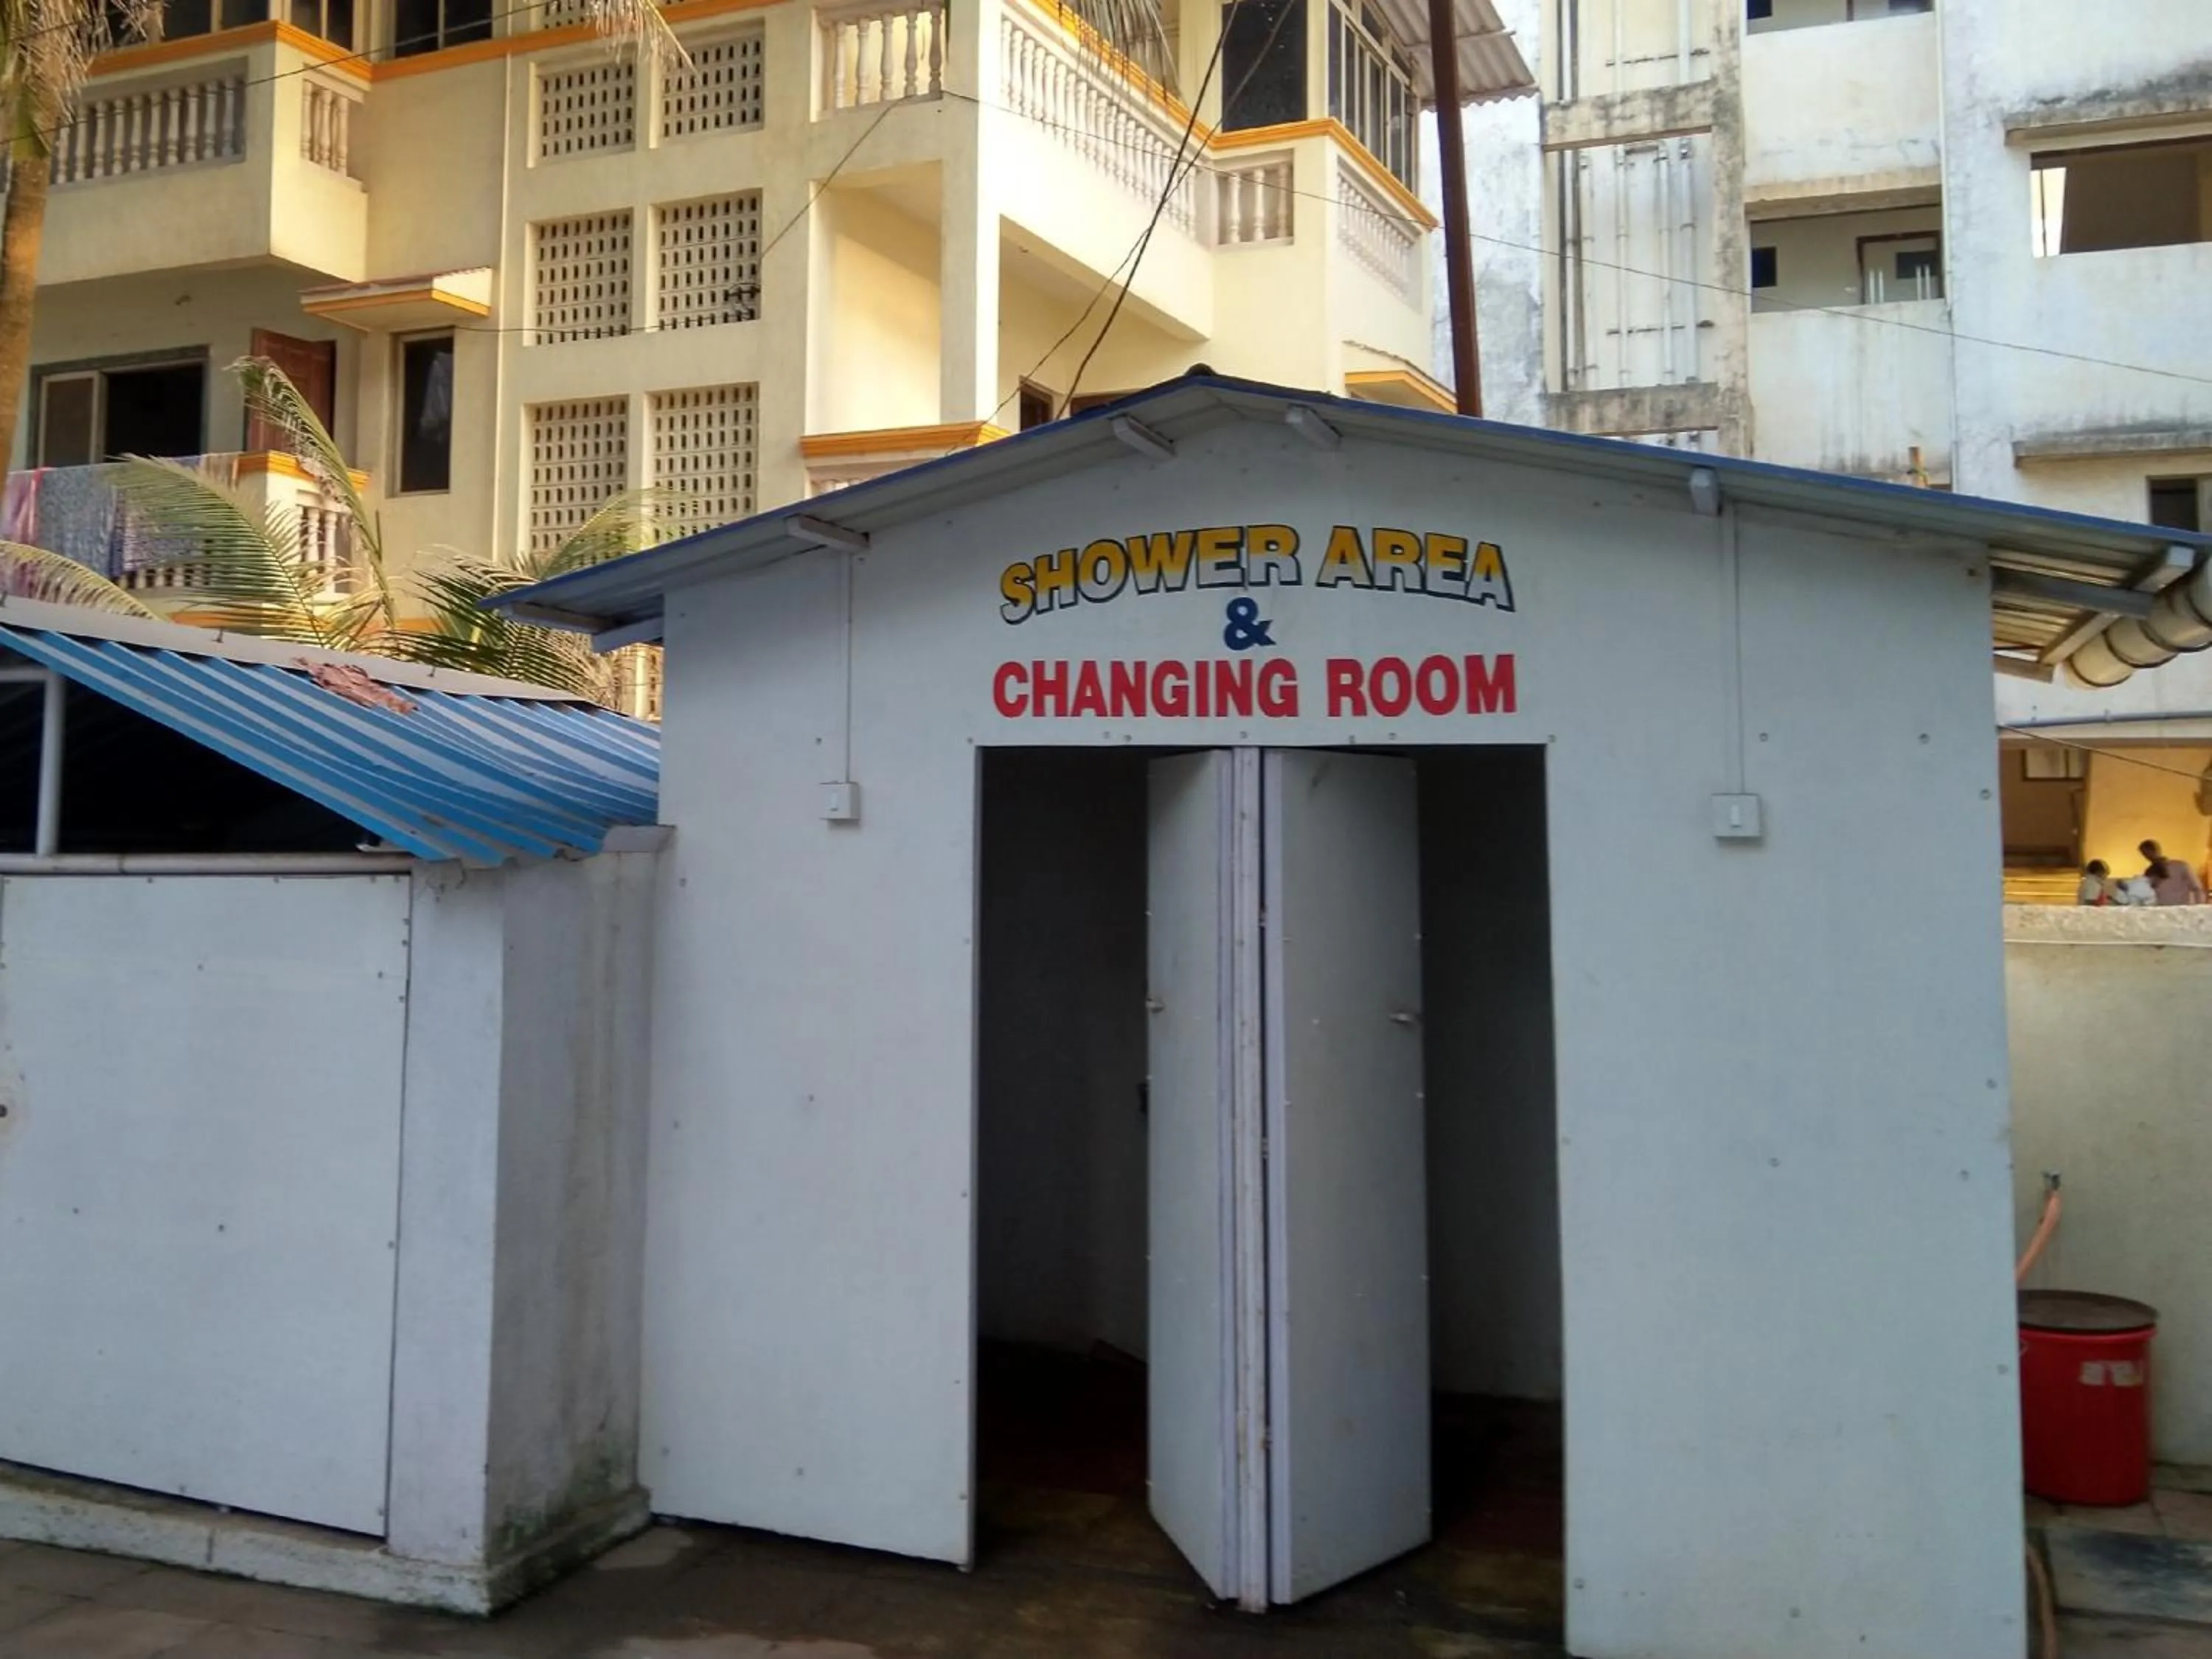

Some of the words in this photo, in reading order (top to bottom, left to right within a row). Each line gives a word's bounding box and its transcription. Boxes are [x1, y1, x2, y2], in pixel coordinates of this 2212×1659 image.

[1000, 524, 1301, 625] SHOWER
[1316, 526, 1516, 612] AREA
[1224, 597, 1276, 650] &
[994, 658, 1298, 717] CHANGING
[1327, 655, 1517, 717] ROOM
